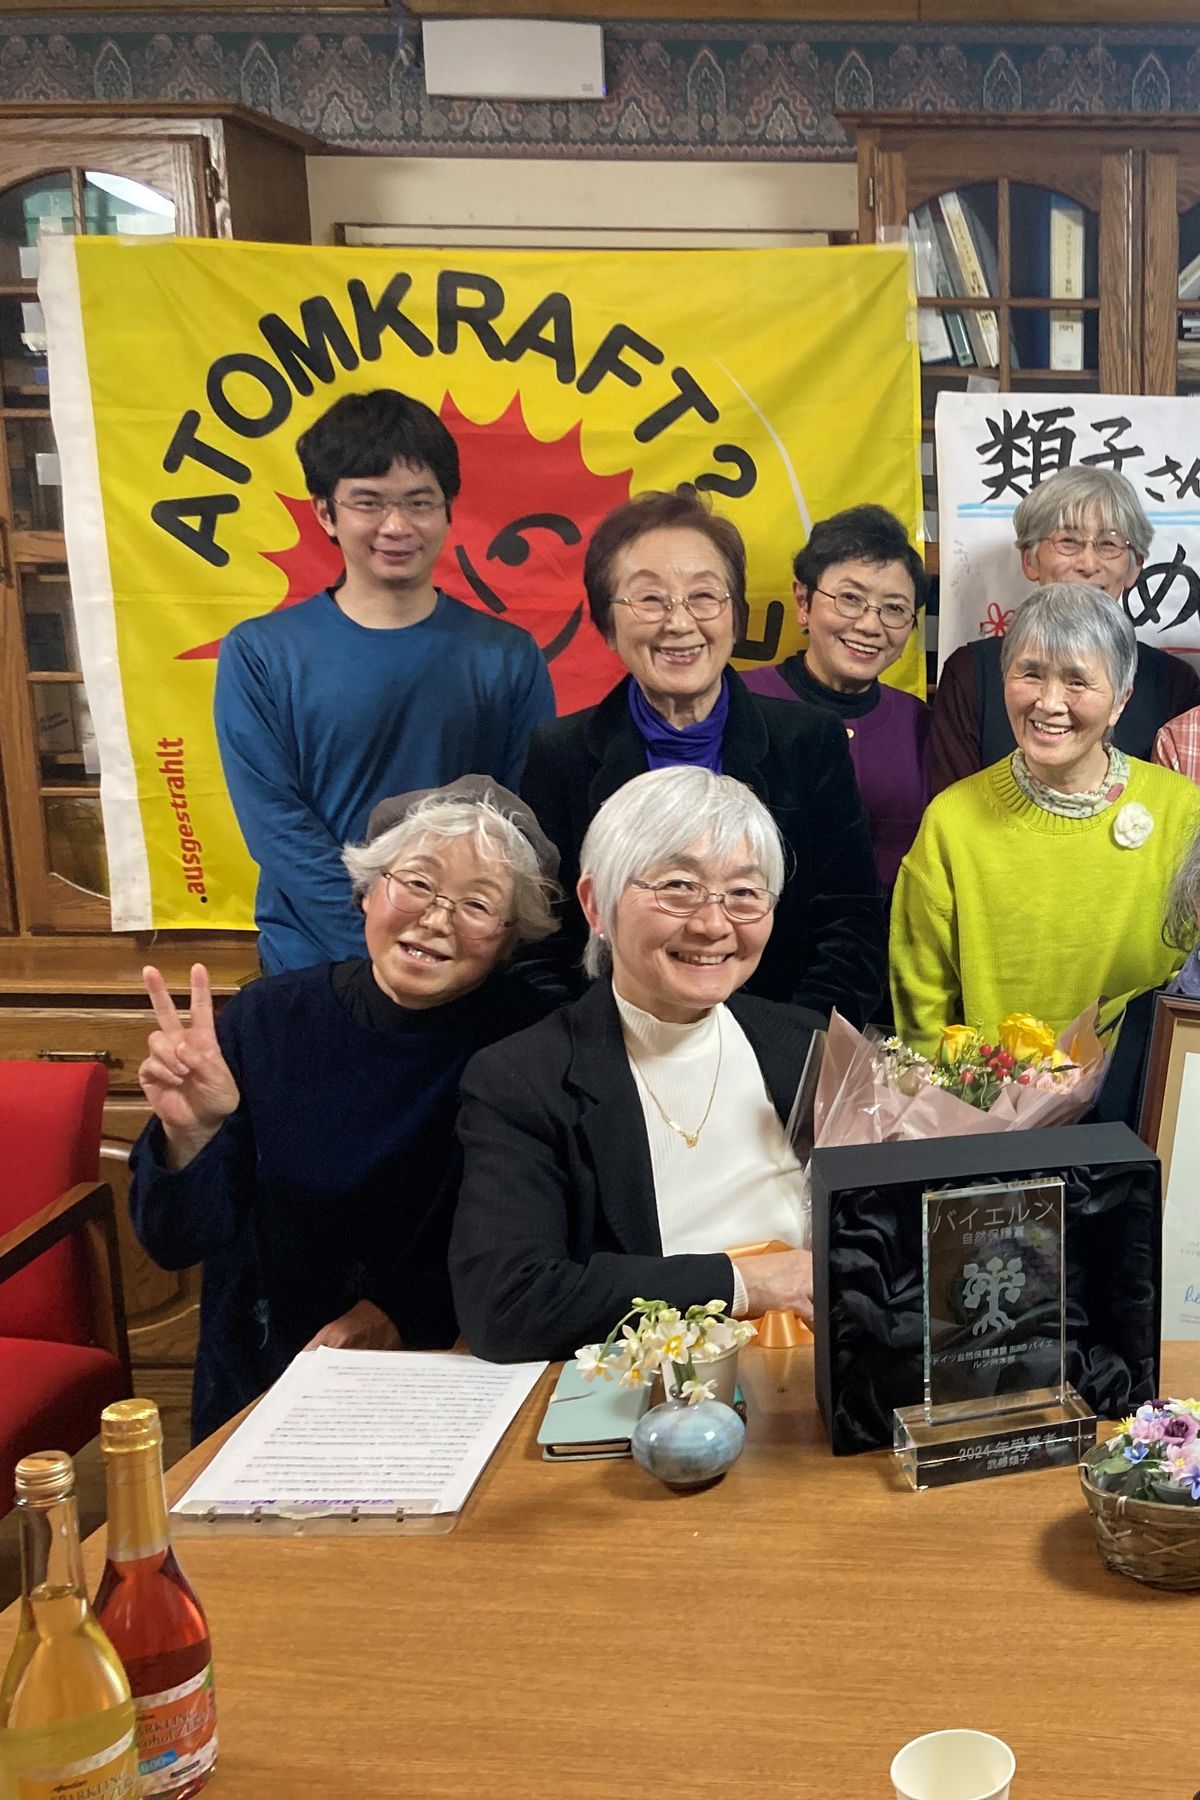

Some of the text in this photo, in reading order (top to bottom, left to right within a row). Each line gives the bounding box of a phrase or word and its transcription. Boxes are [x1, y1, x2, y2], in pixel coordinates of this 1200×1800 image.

[151, 270, 758, 567] ATOMKRAFT?
[155, 737, 208, 904] .ausgestrahlt
[932, 1201, 1055, 1234] バイエルン
